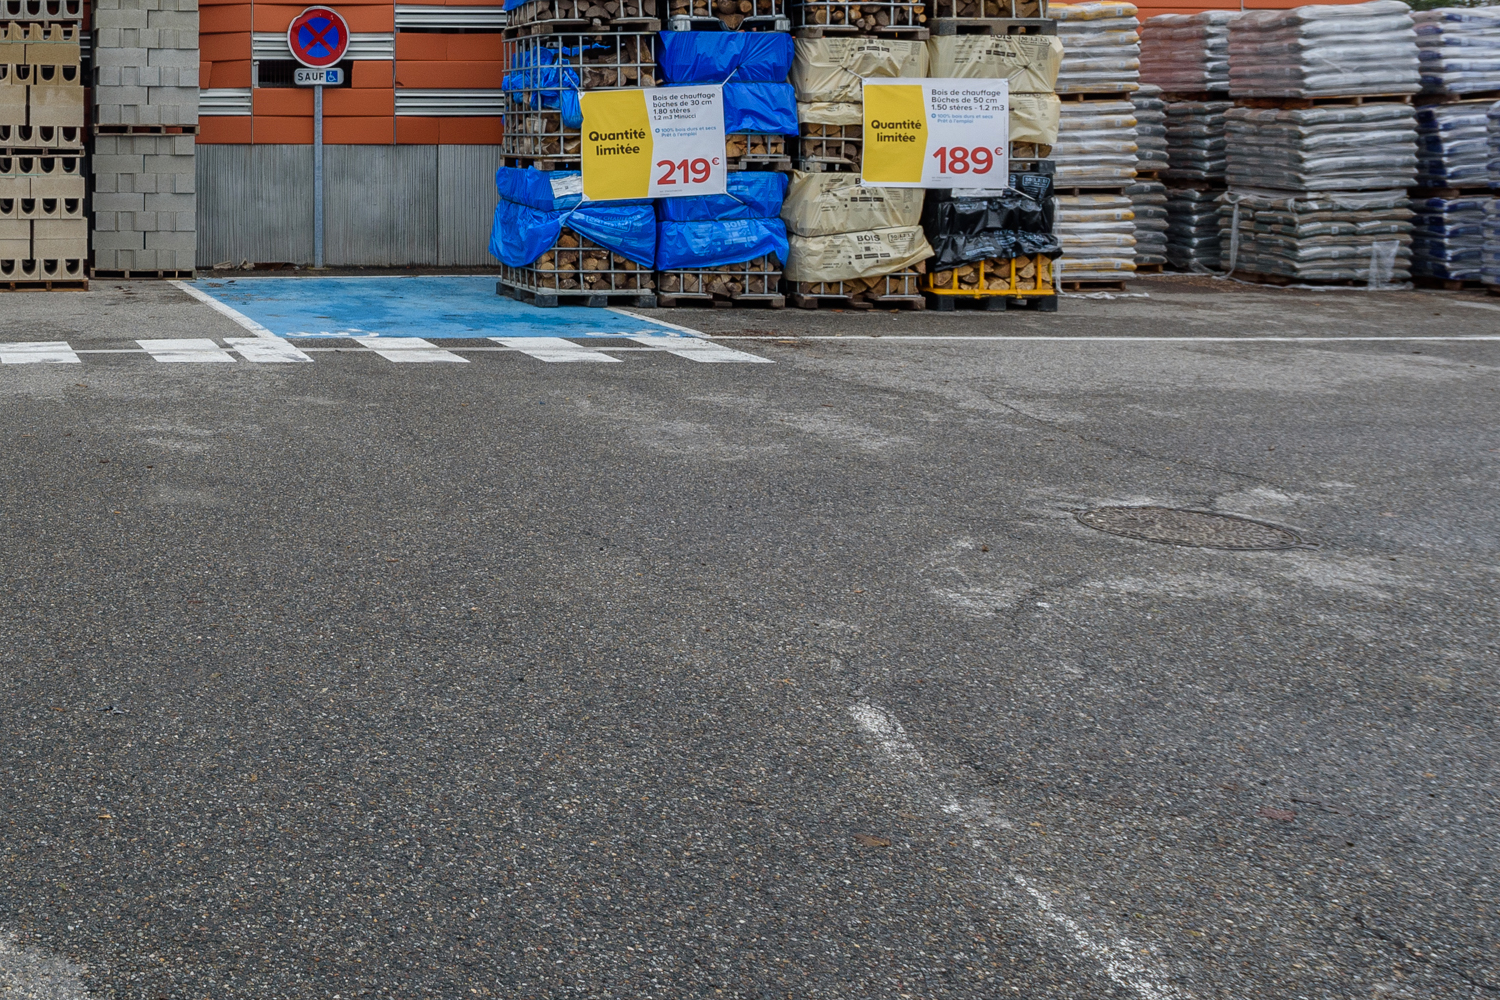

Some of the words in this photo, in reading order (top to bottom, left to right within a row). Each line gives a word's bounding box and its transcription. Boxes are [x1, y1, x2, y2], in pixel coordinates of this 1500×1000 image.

[297, 72, 325, 81] SAUF
[680, 92, 716, 100] chauffage
[962, 89, 1001, 98] chauffage
[871, 119, 922, 130] Quantité
[589, 128, 646, 142] Quantité
[876, 132, 916, 143] limitée
[596, 143, 640, 156] limitée
[856, 234, 881, 242] BOIS
